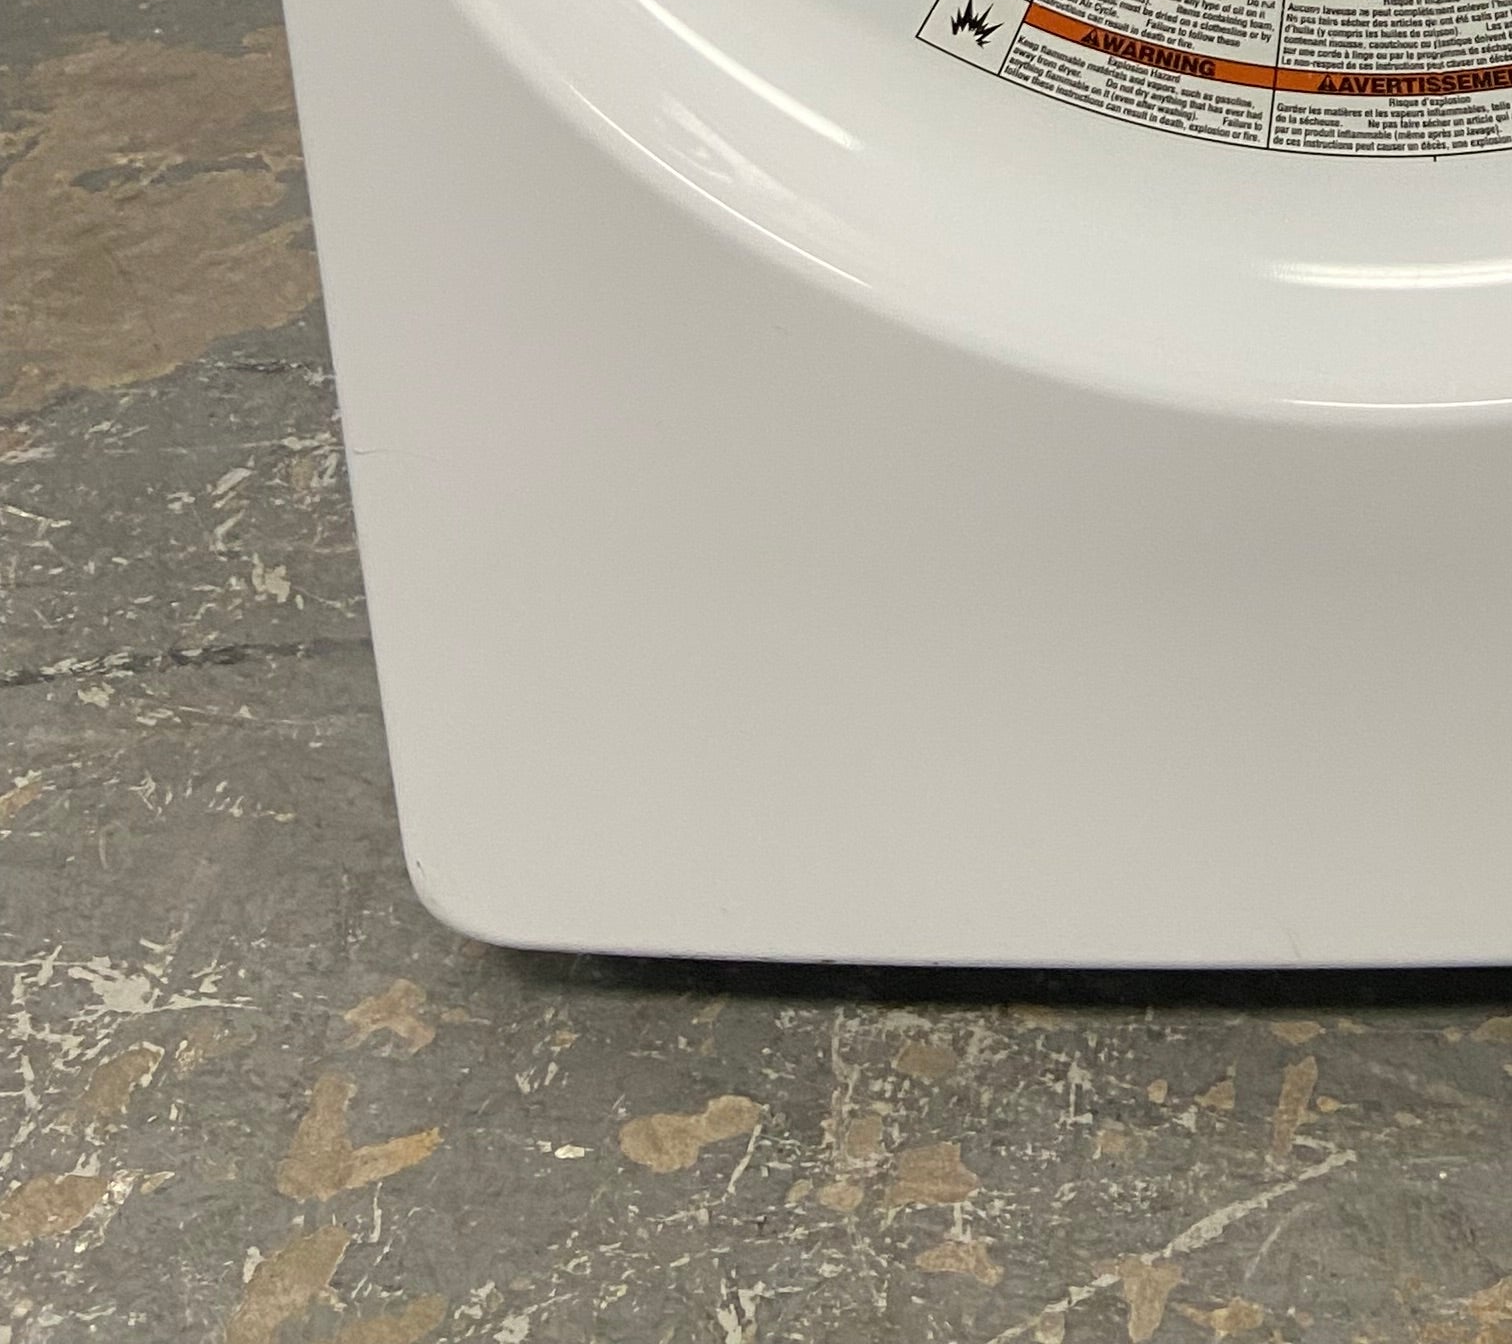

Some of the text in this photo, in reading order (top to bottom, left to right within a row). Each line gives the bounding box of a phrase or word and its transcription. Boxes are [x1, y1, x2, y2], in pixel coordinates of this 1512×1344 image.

[1103, 33, 1216, 77] WARNING
[1108, 56, 1180, 84] Explosion Hazard
[1106, 79, 1118, 89] Do
[1120, 83, 1134, 94] not
[1135, 86, 1150, 99] dry
[1106, 102, 1121, 114] can
[1389, 96, 1420, 108] Risque
